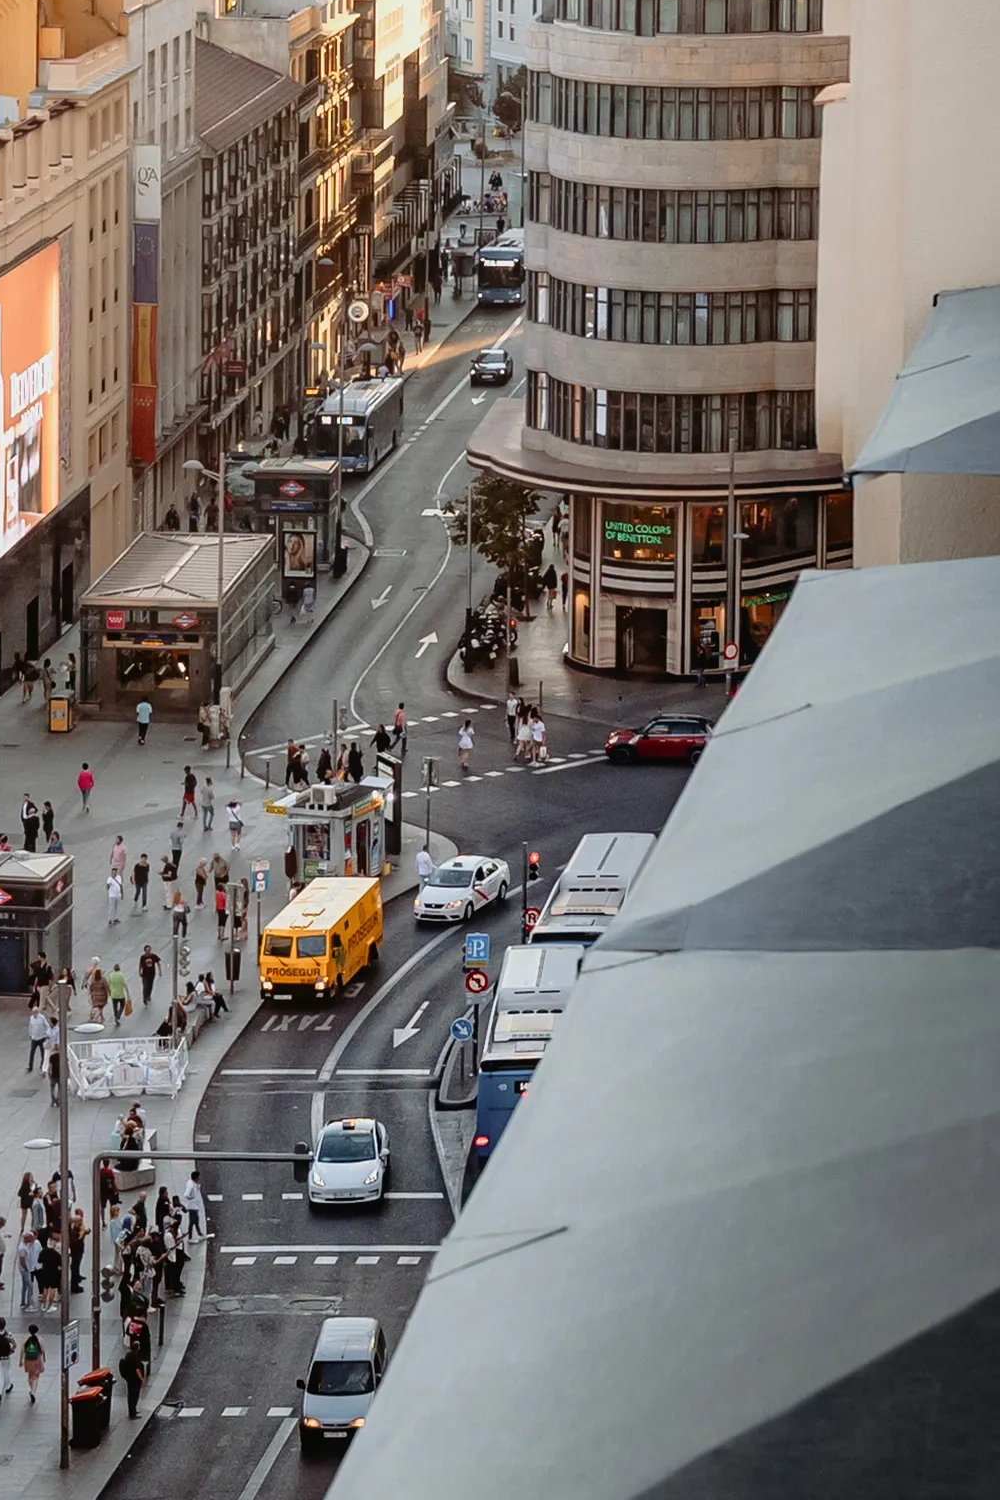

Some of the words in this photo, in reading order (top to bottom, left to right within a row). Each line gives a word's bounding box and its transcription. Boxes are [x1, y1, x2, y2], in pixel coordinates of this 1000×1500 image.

[605, 521, 634, 533] UNITED
[635, 524, 672, 535] COLORS
[605, 531, 616, 539] OF
[471, 939, 485, 958] P
[266, 967, 321, 977] PROSEGUR
[260, 1013, 337, 1033] TAXI
